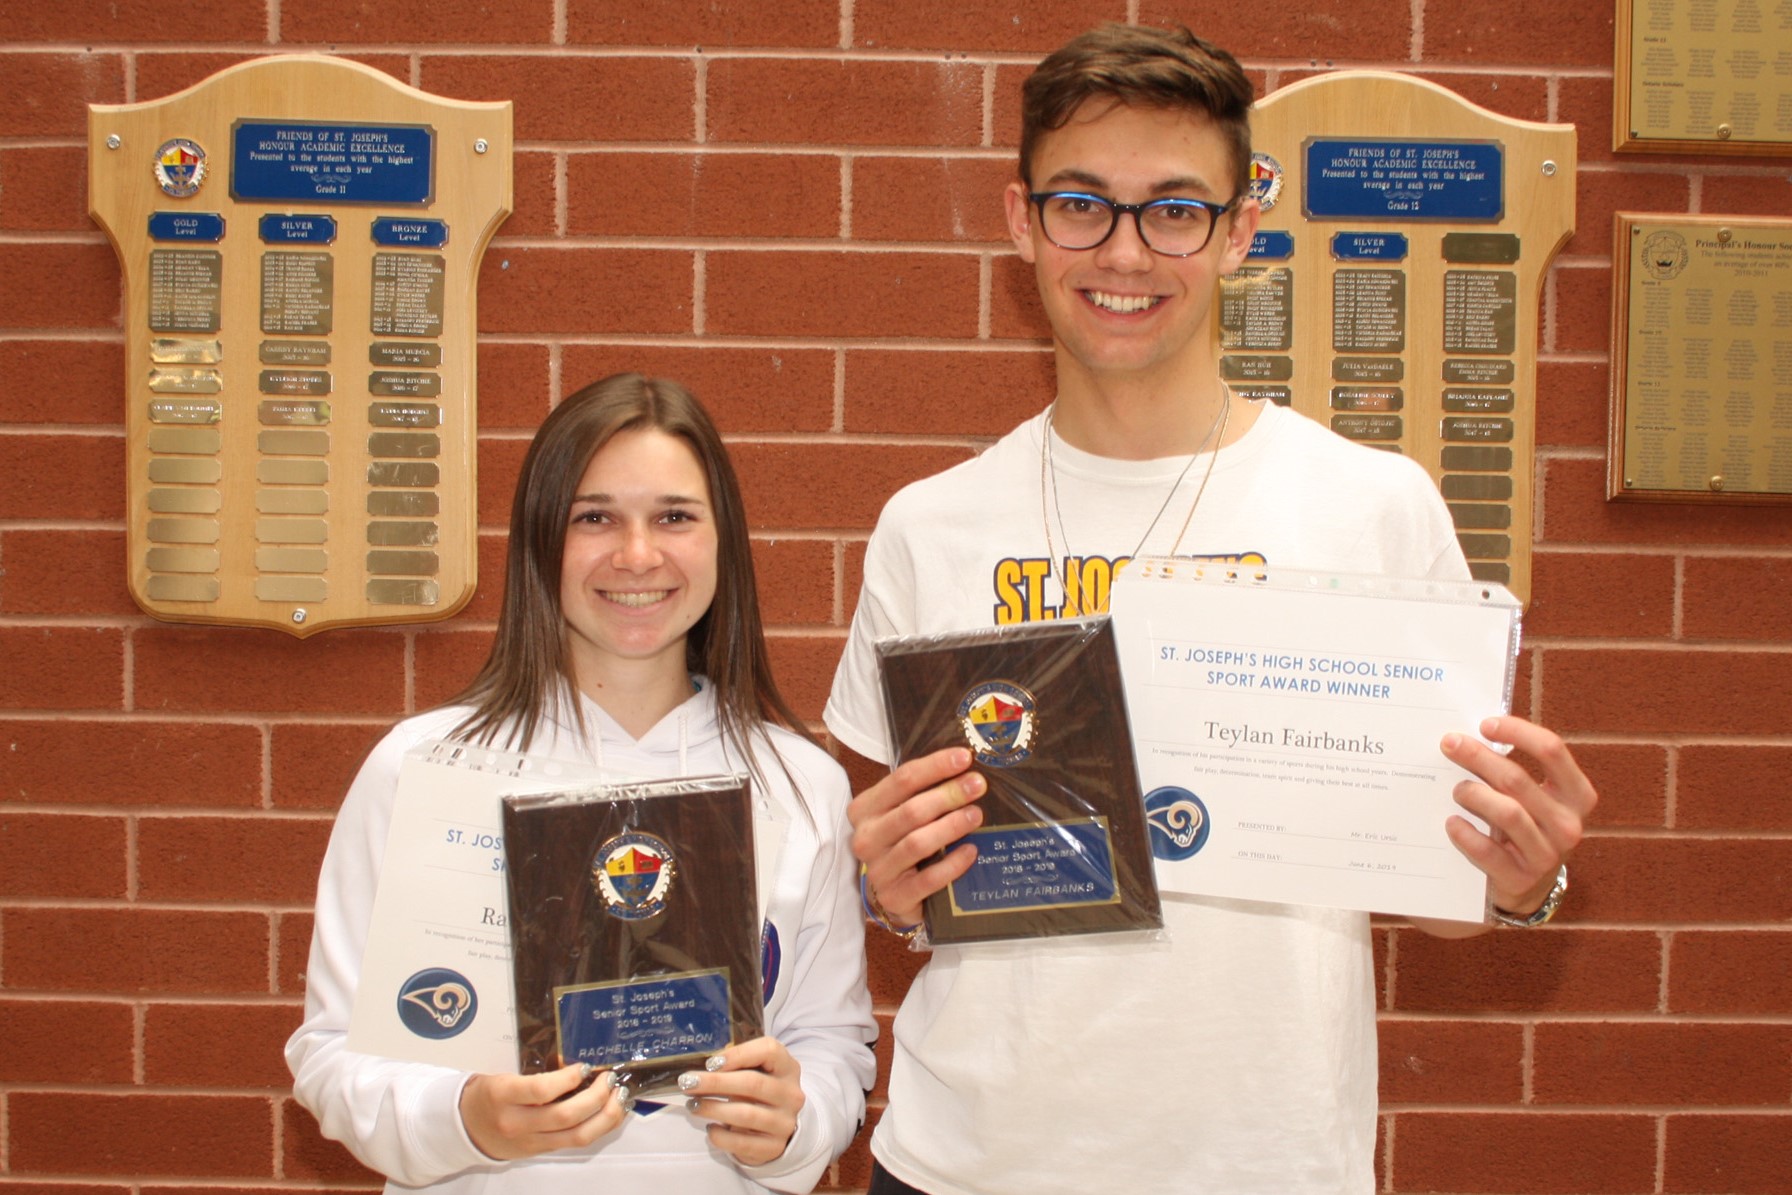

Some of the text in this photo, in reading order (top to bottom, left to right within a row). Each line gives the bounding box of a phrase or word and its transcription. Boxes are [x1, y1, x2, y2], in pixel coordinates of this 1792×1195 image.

[277, 131, 388, 143] FRIENDS OF ST. JOSEPH'S
[259, 142, 405, 153] HONOUR ACADEMIC EXCELLENCE
[1349, 148, 1460, 158] FRIENDS OF ST. JOSEPH'S
[250, 152, 283, 160] Presented
[301, 153, 311, 162] the
[317, 154, 345, 162] students
[351, 154, 367, 163] with
[372, 155, 383, 163] the
[388, 155, 413, 165] highest
[1331, 158, 1476, 169] HONOUR ACADEMIC EXCELLENCE
[291, 164, 372, 174] average in each year
[1322, 169, 1484, 182] Presented to the students with the highest
[316, 185, 346, 194] Grade 11
[1363, 181, 1444, 191] average in each year
[1387, 201, 1419, 210] Grade 12
[392, 225, 427, 233] BRONZE
[1353, 238, 1385, 246] SILVER
[1696, 239, 1776, 250] Principal's Honour
[1160, 646, 1444, 682] ST. JOSEPH'S HIGH SCHOOL SENIOR
[1207, 671, 1390, 699] SPORT AWARD WINNER
[1204, 721, 1384, 755] Teylan Fairbanks
[1210, 754, 1244, 763] participation
[1336, 764, 1349, 773] high
[1306, 778, 1325, 786] giving
[1238, 822, 1275, 831] PRESENTED
[447, 829, 465, 844] ST.
[1012, 837, 1055, 850] Joseph's
[978, 848, 1076, 865] Senior Sport Award
[972, 882, 1094, 901] TEYLAN FAIRBANKS
[631, 990, 675, 1002] Joseph's
[592, 999, 695, 1019] Senior Sport Award
[578, 1033, 713, 1058] RACHELLE CHARRON
